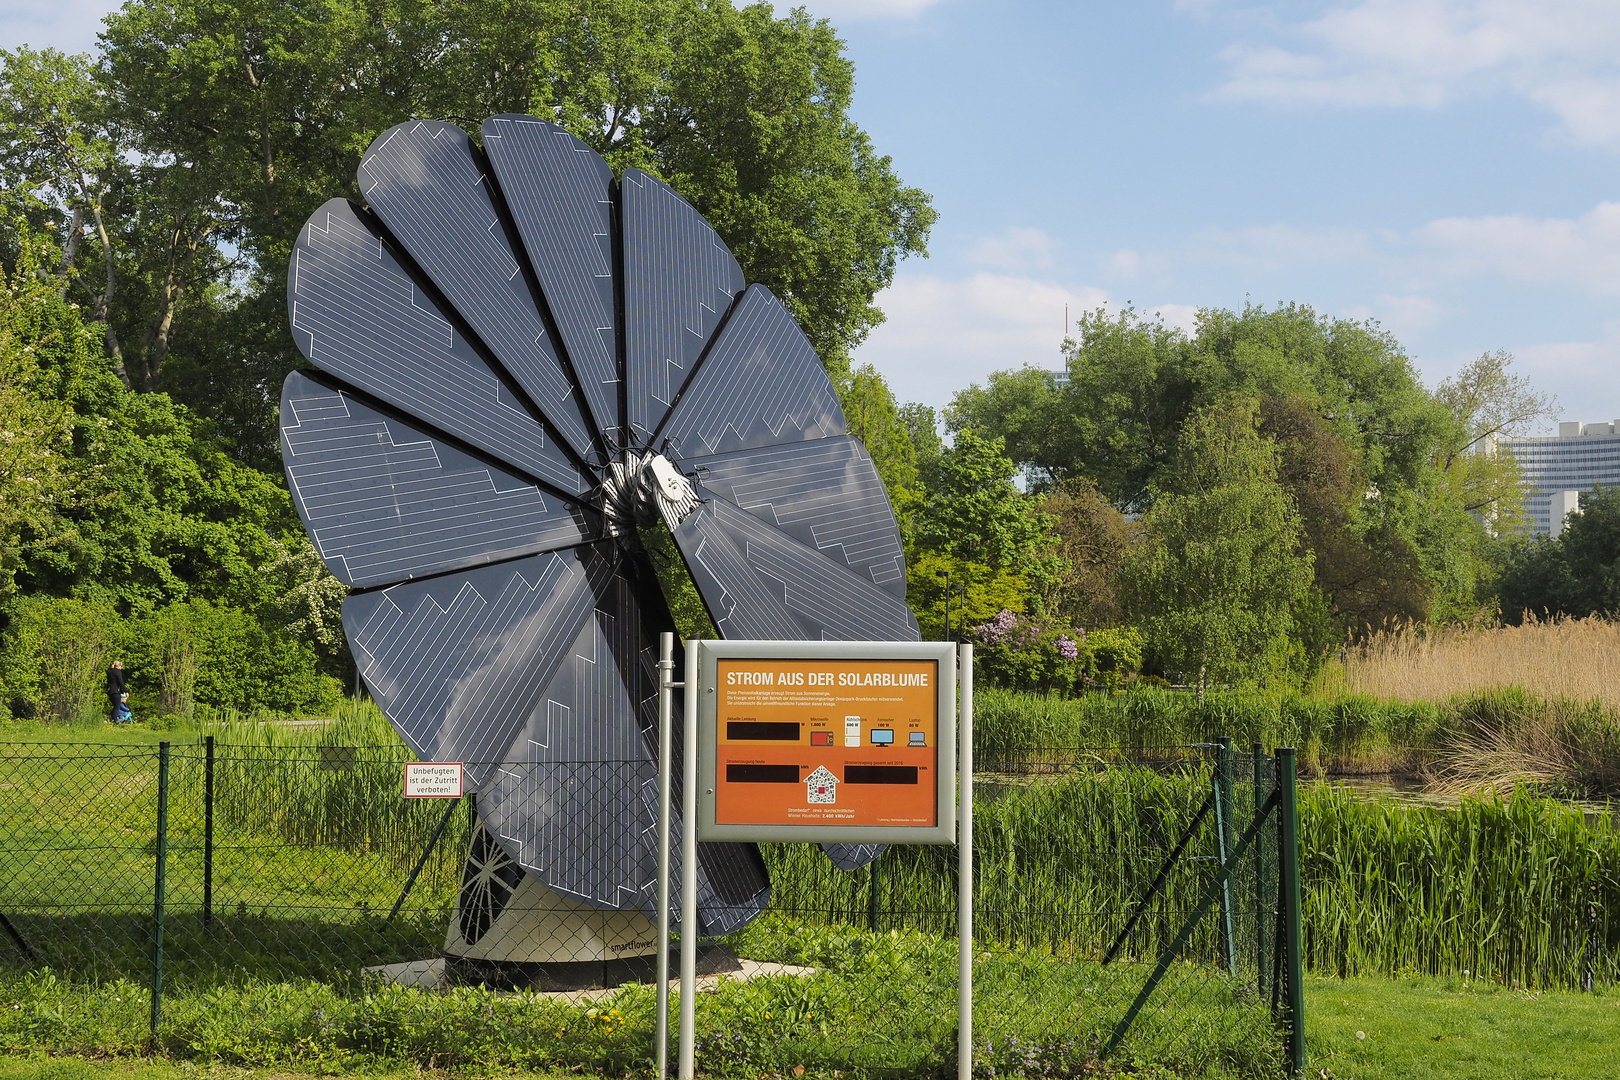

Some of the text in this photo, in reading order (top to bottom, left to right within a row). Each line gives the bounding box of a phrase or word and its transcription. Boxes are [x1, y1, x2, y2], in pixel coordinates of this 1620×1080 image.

[727, 672, 928, 687] STROM AUS DER SOLARBLUME
[413, 768, 454, 776] Unbefugten
[416, 786, 451, 794] verboten!
[610, 940, 653, 952] smartflower
